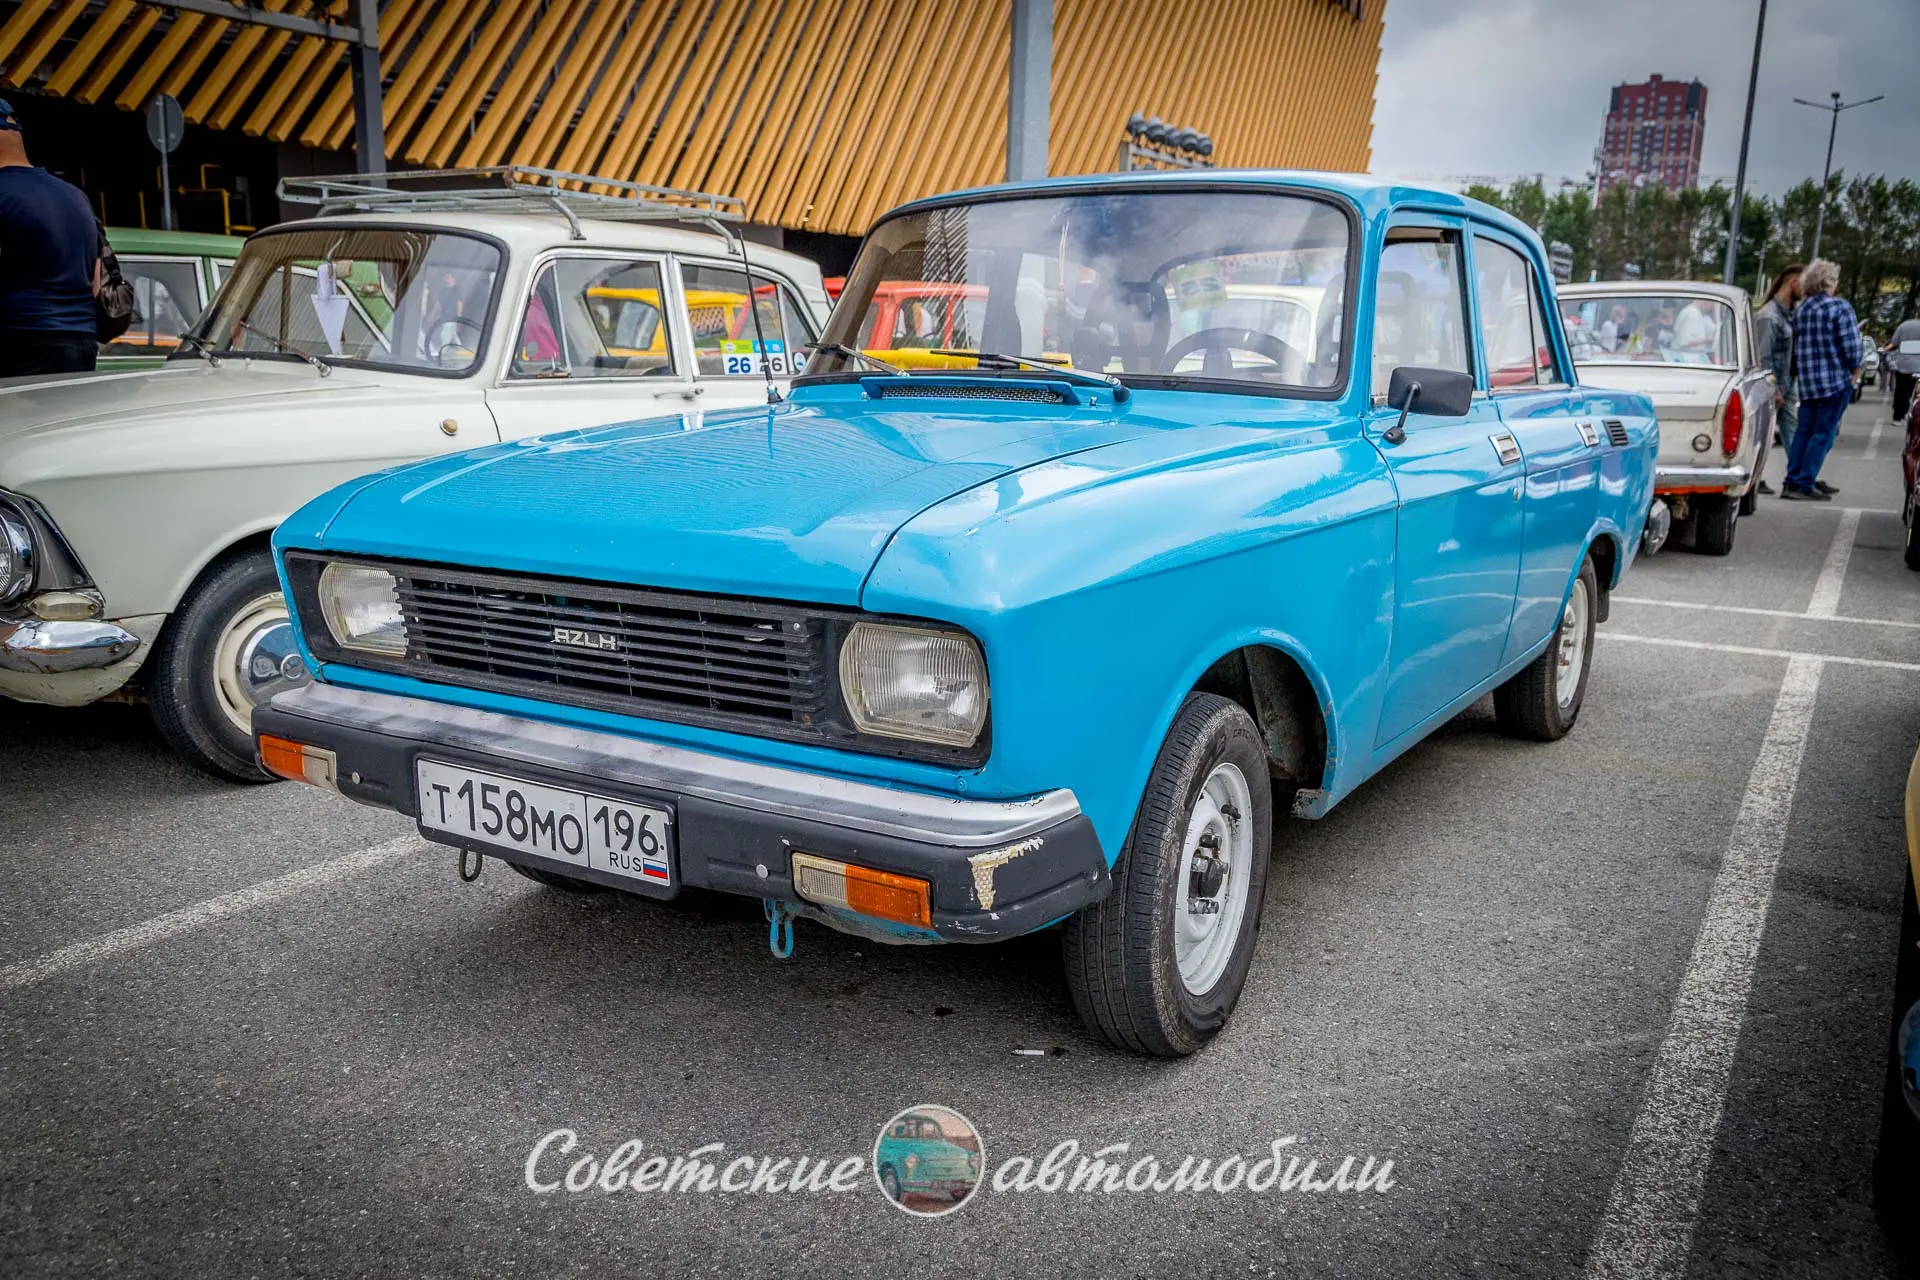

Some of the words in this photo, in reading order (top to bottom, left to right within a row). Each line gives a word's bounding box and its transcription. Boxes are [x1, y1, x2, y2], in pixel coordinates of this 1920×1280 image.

[728, 357, 751, 374] 26
[431, 779, 584, 856] Т158МО
[593, 805, 659, 856] 196
[609, 851, 642, 872] RUS
